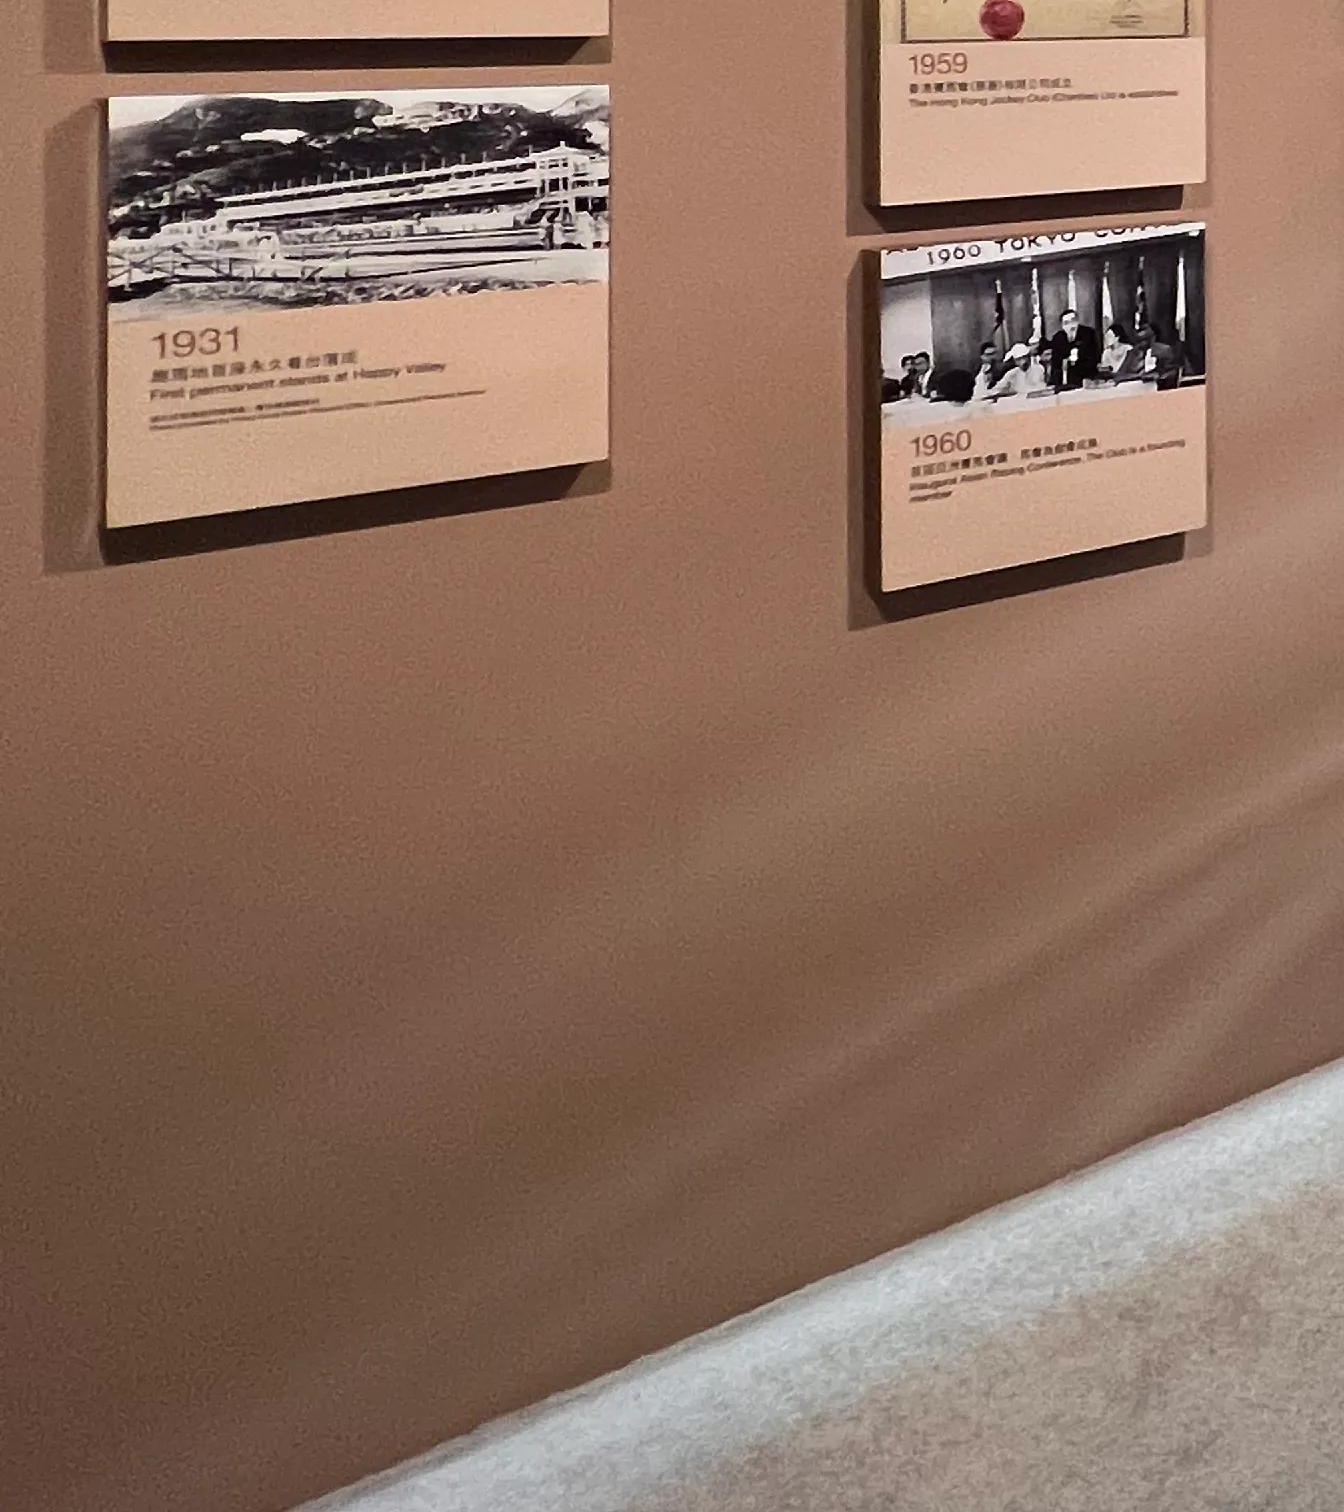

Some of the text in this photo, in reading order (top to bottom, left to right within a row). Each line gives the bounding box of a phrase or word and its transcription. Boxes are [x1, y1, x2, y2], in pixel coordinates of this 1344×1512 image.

[907, 52, 969, 75] 1959
[926, 244, 982, 266] 1960
[151, 326, 241, 360] 1931
[909, 429, 973, 458] 1960
